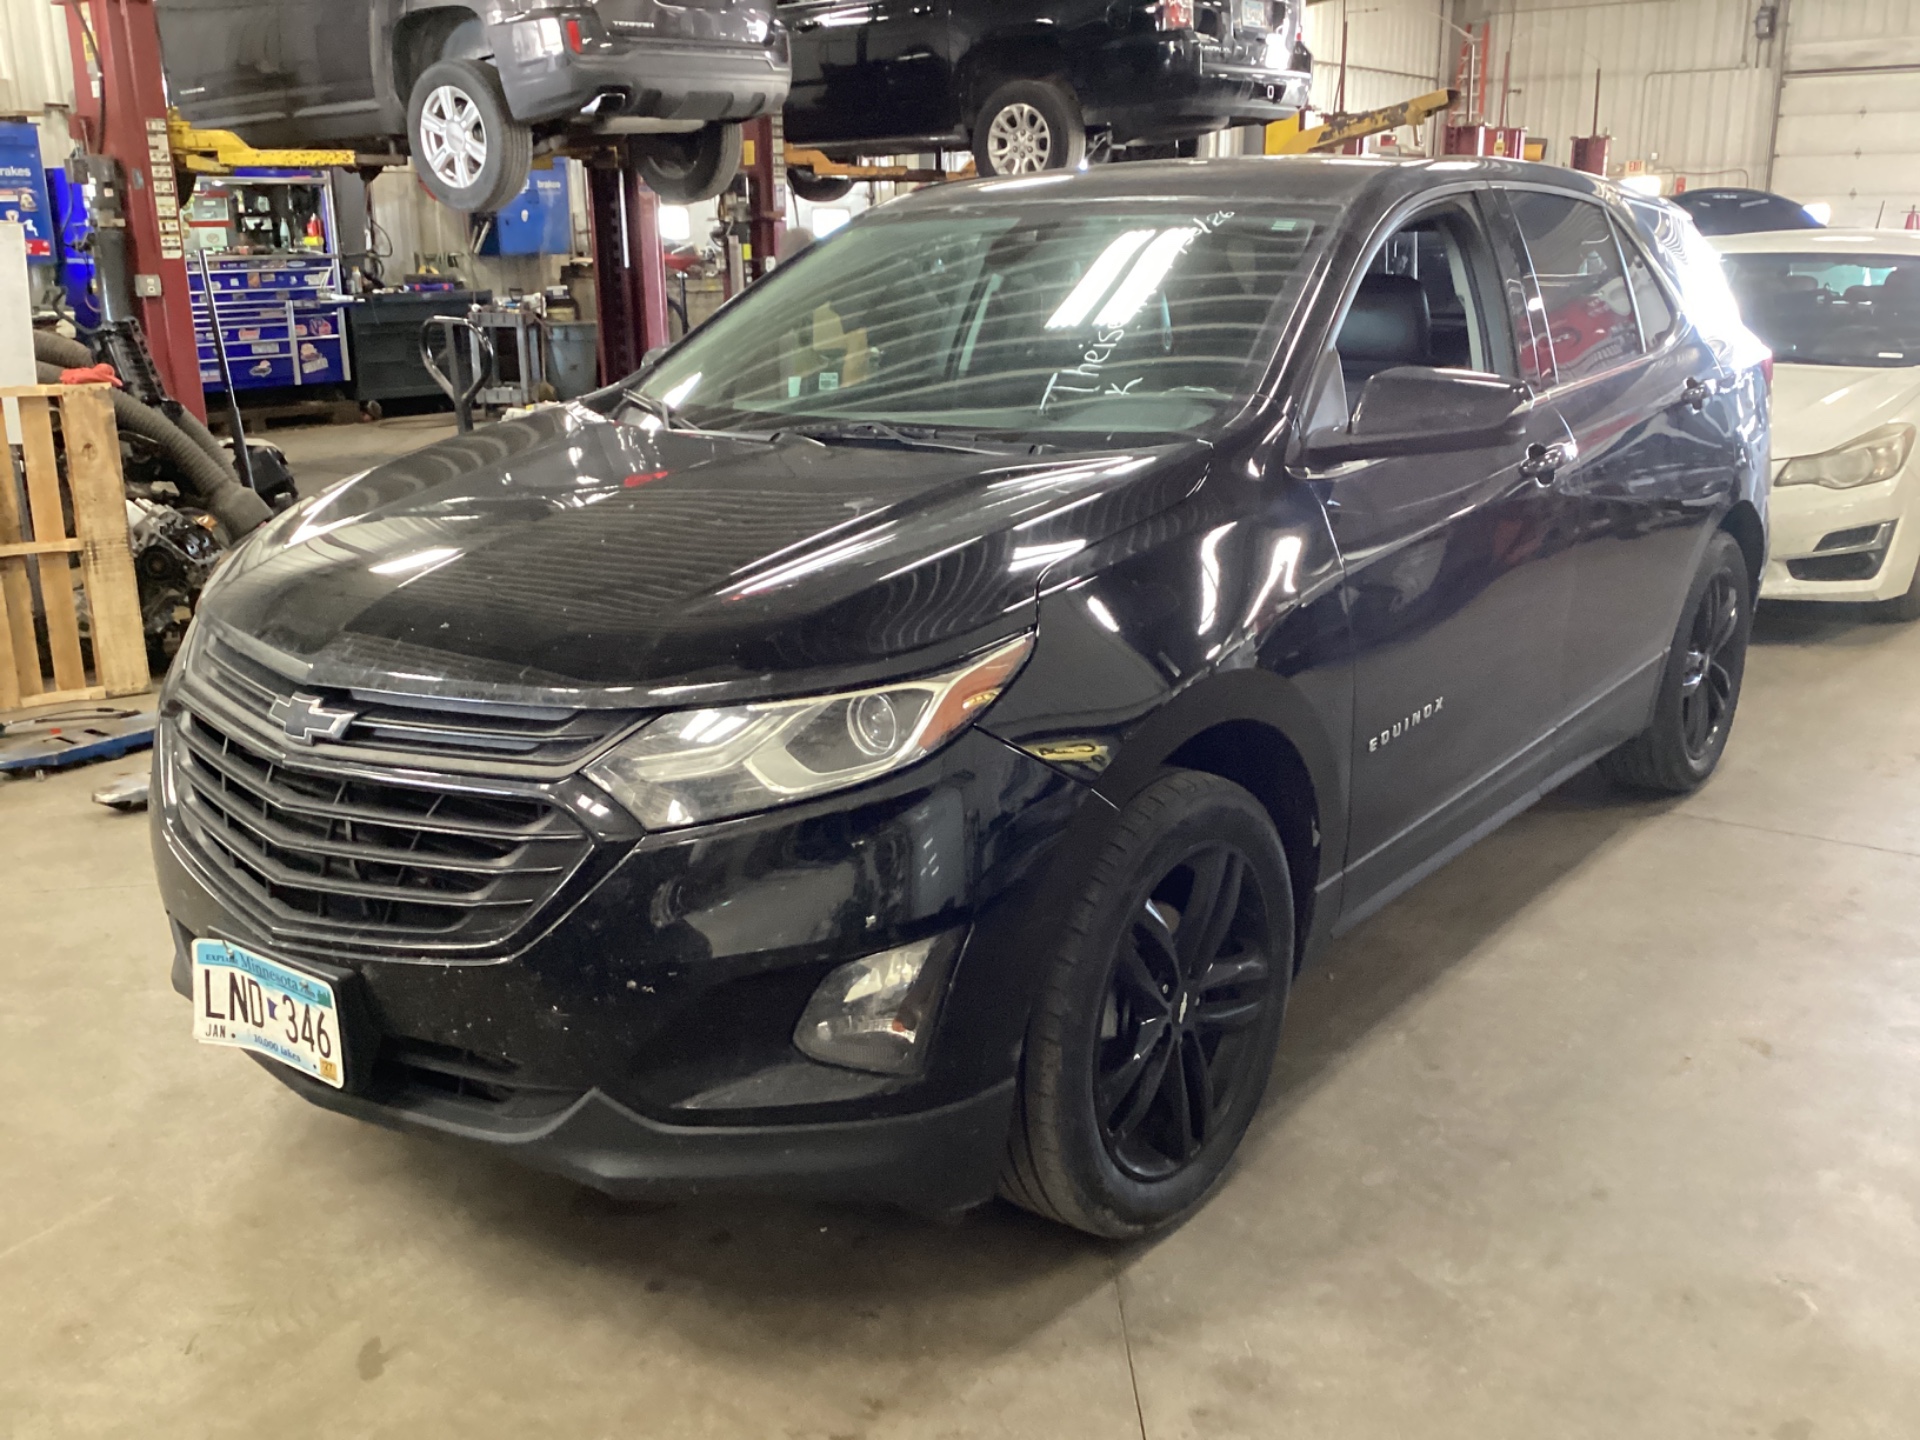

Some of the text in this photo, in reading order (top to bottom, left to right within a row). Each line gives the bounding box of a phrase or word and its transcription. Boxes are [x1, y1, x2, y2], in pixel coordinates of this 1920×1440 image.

[1368, 696, 1443, 753] EQUINOX
[239, 952, 299, 991] Minnesota
[205, 969, 332, 1059] LND 346
[205, 1023, 226, 1038] JAN
